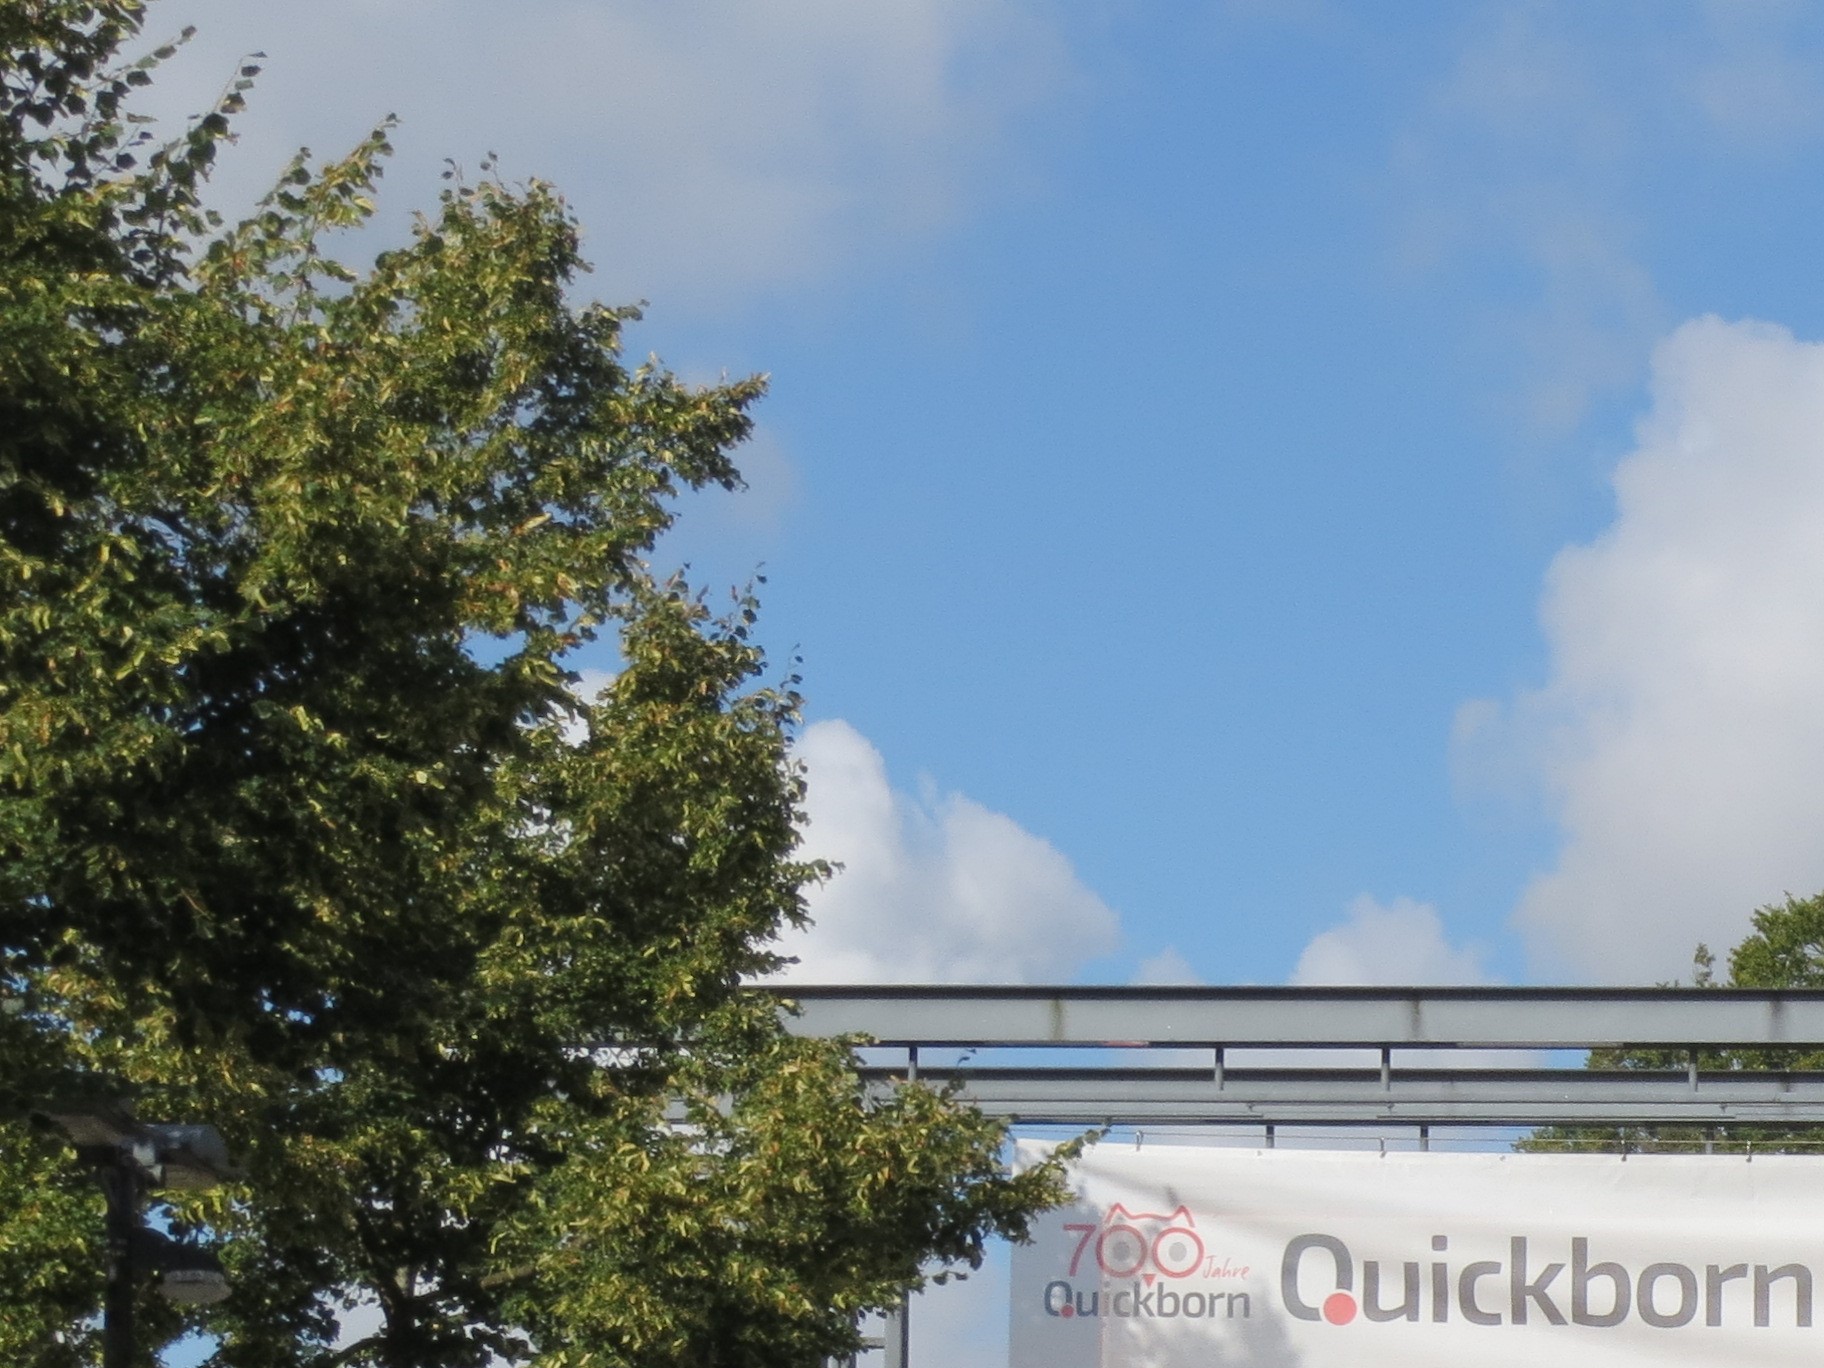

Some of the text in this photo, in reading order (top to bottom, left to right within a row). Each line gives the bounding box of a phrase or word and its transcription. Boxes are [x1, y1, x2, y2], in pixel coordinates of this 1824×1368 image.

[1063, 1223, 1250, 1280] 700 Jahre
[1280, 1232, 1813, 1328] Quickborn
[1044, 1280, 1250, 1319] Quickborn
